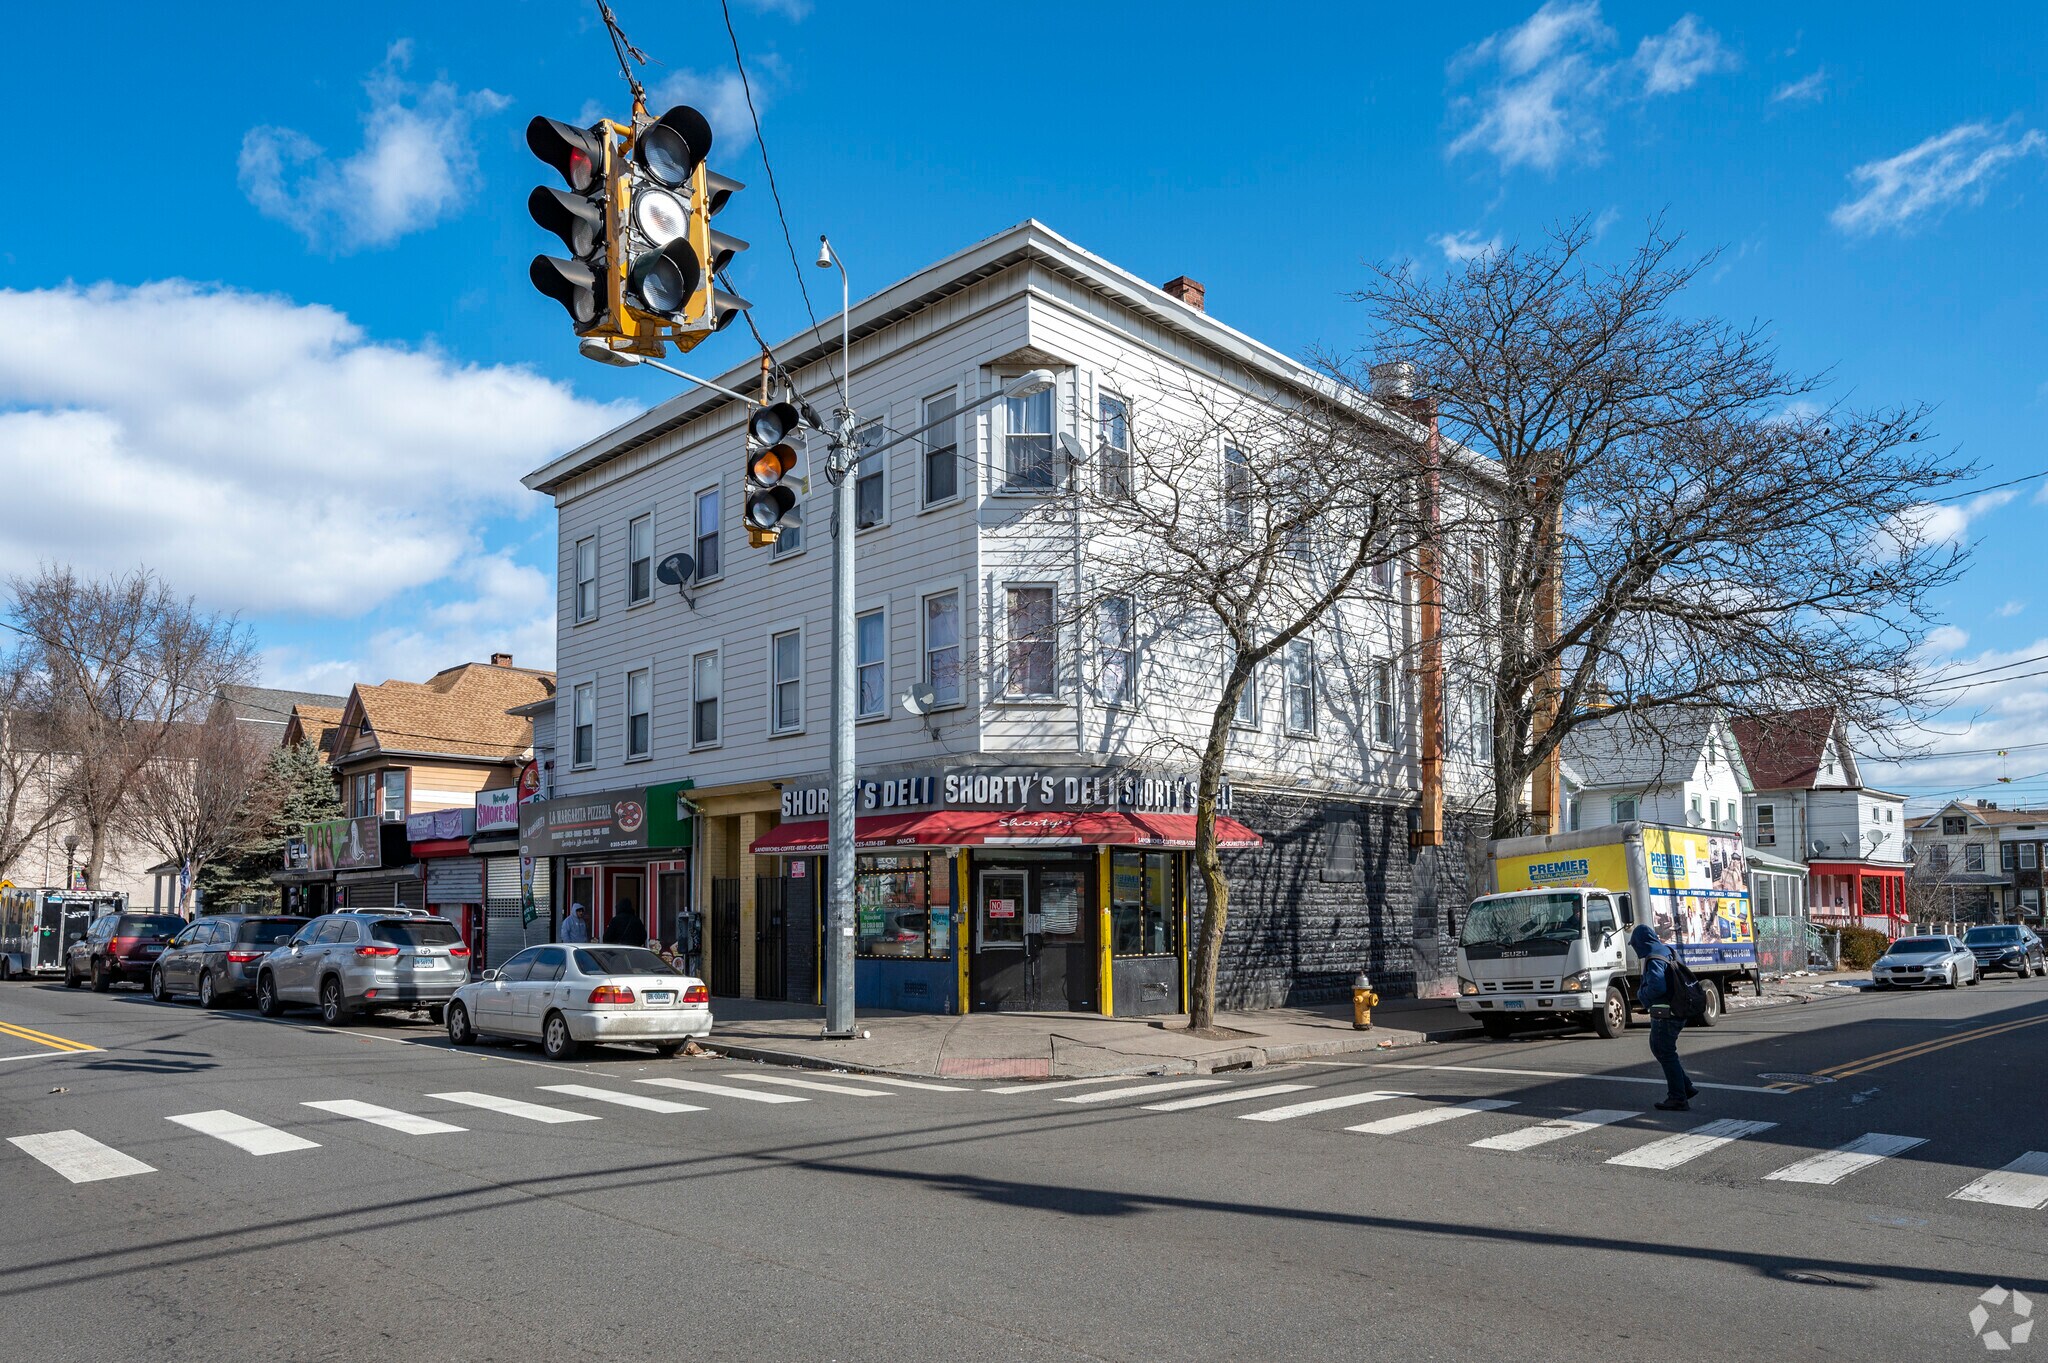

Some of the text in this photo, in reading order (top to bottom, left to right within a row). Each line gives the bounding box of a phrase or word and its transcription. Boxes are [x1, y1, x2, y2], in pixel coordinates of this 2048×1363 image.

[781, 776, 932, 817] SHOR'S DELI
[945, 772, 1116, 805] SHORTY'S DELI
[1125, 776, 1198, 809] SHORTY'S
[477, 803, 503, 829] SMOKE
[504, 801, 519, 823] SHO
[556, 806, 587, 824] MARGARITA
[587, 804, 612, 821] PIZZERIA
[998, 817, 1073, 829] Shorty's
[896, 837, 916, 845] SNACKS
[1528, 859, 1589, 876] PREMIER
[1650, 851, 1685, 868] PREMIER
[991, 901, 1002, 910] NO
[1501, 950, 1529, 958] ISUZU
